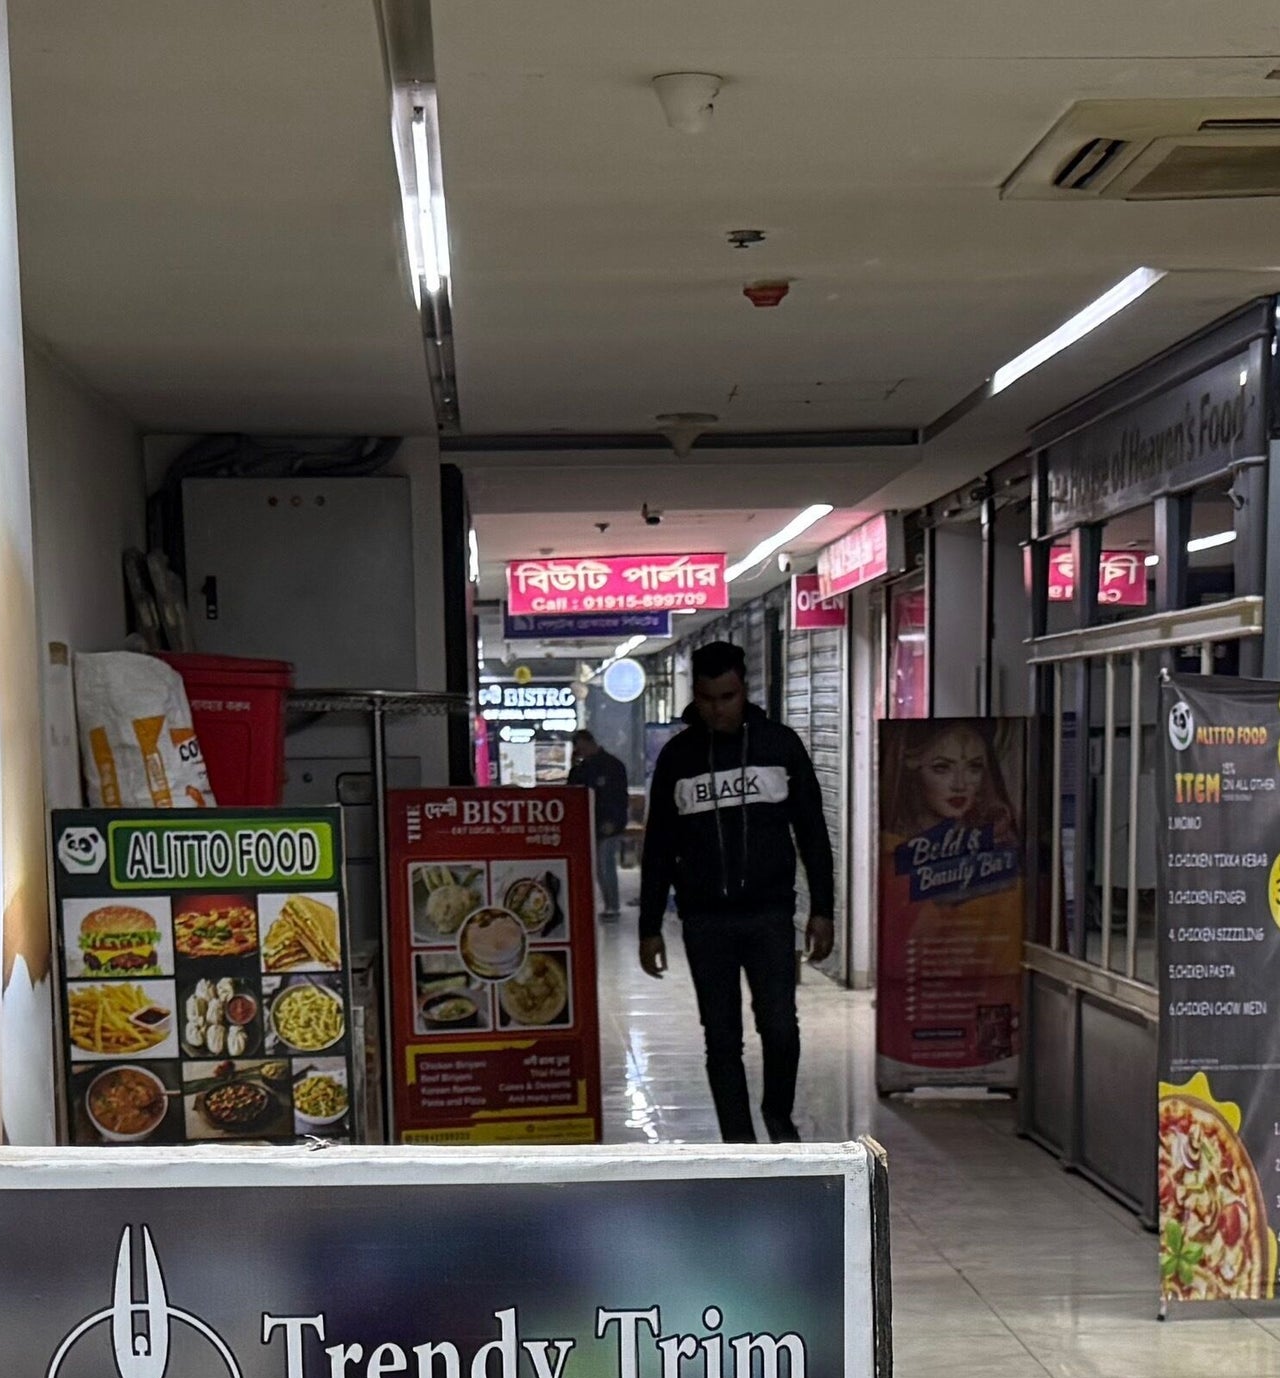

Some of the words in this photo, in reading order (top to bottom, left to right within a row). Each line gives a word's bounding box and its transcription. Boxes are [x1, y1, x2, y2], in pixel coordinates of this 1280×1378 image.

[1198, 384, 1248, 456] Food
[514, 561, 612, 594] বিউটি
[622, 557, 719, 590] পার্লার
[531, 597, 568, 612] Call
[1196, 726, 1235, 745] ALITTO
[1238, 726, 1267, 745] FOOD
[1175, 772, 1220, 804] ITEM
[407, 805, 422, 844] THE
[463, 799, 565, 825] BISTRO
[126, 829, 232, 880] ALITTO
[234, 828, 321, 878] FOOD
[1209, 964, 1235, 978] PASTA
[1215, 1001, 1241, 1015] CHOW
